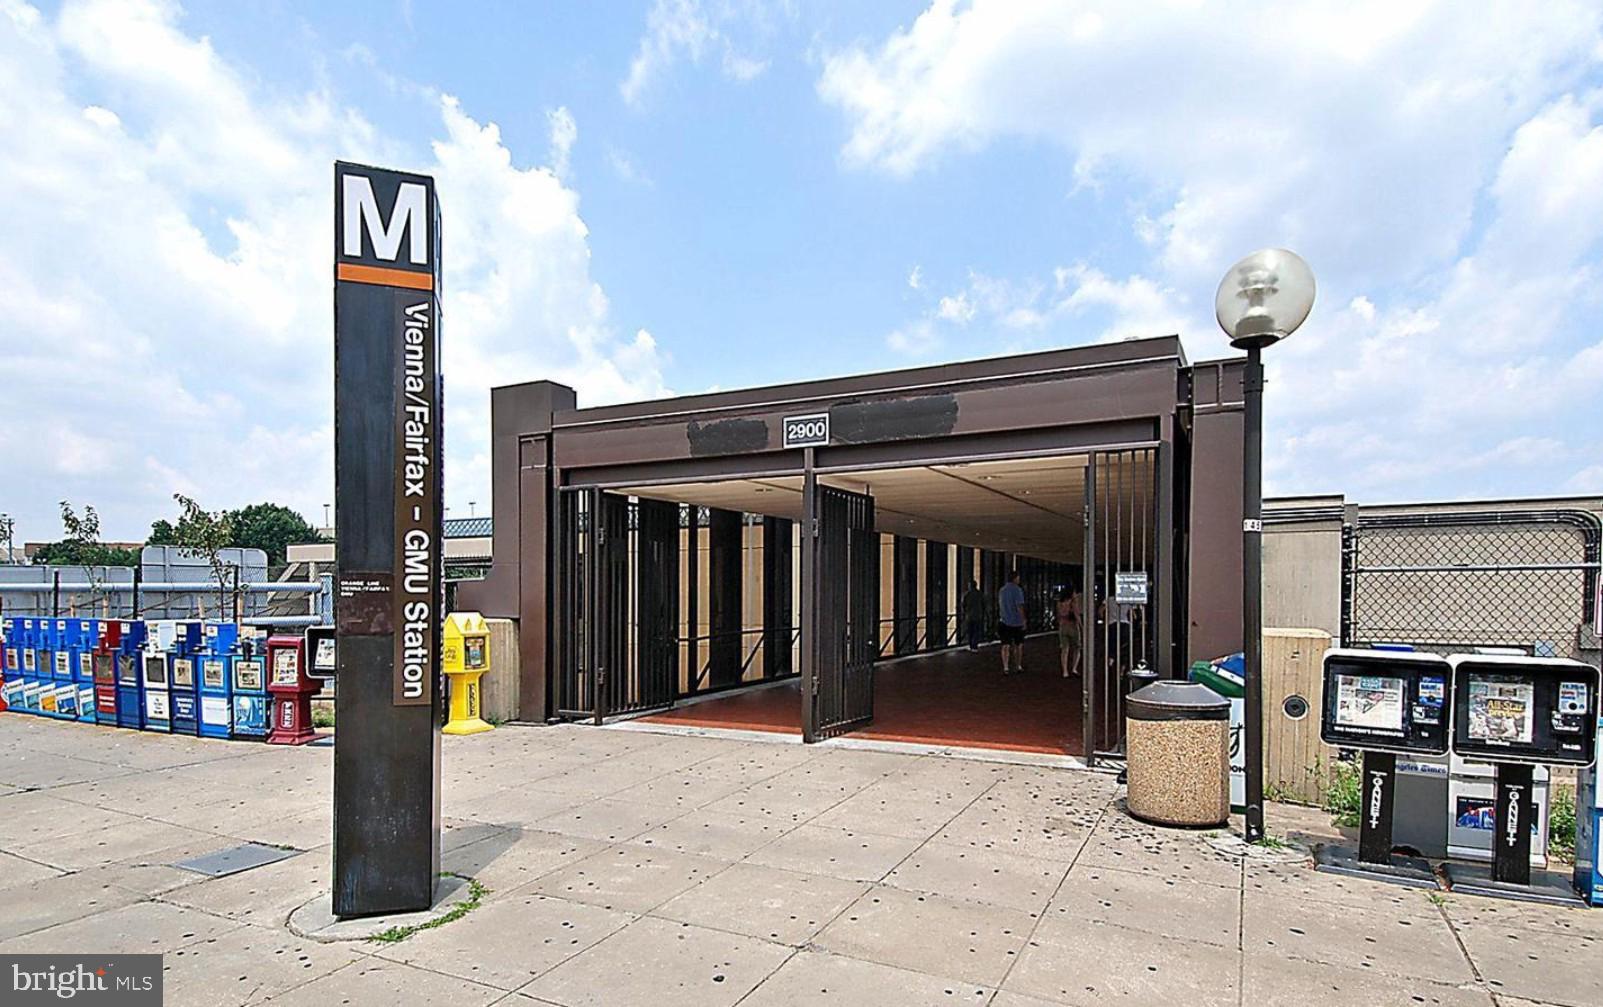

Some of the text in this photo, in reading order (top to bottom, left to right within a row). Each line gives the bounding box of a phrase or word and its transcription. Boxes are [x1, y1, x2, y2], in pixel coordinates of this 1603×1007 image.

[342, 173, 428, 265] M
[404, 302, 430, 497] Vienna/Fairfax
[787, 421, 826, 439] 2900
[403, 529, 430, 594] GMU
[403, 602, 429, 698] Station
